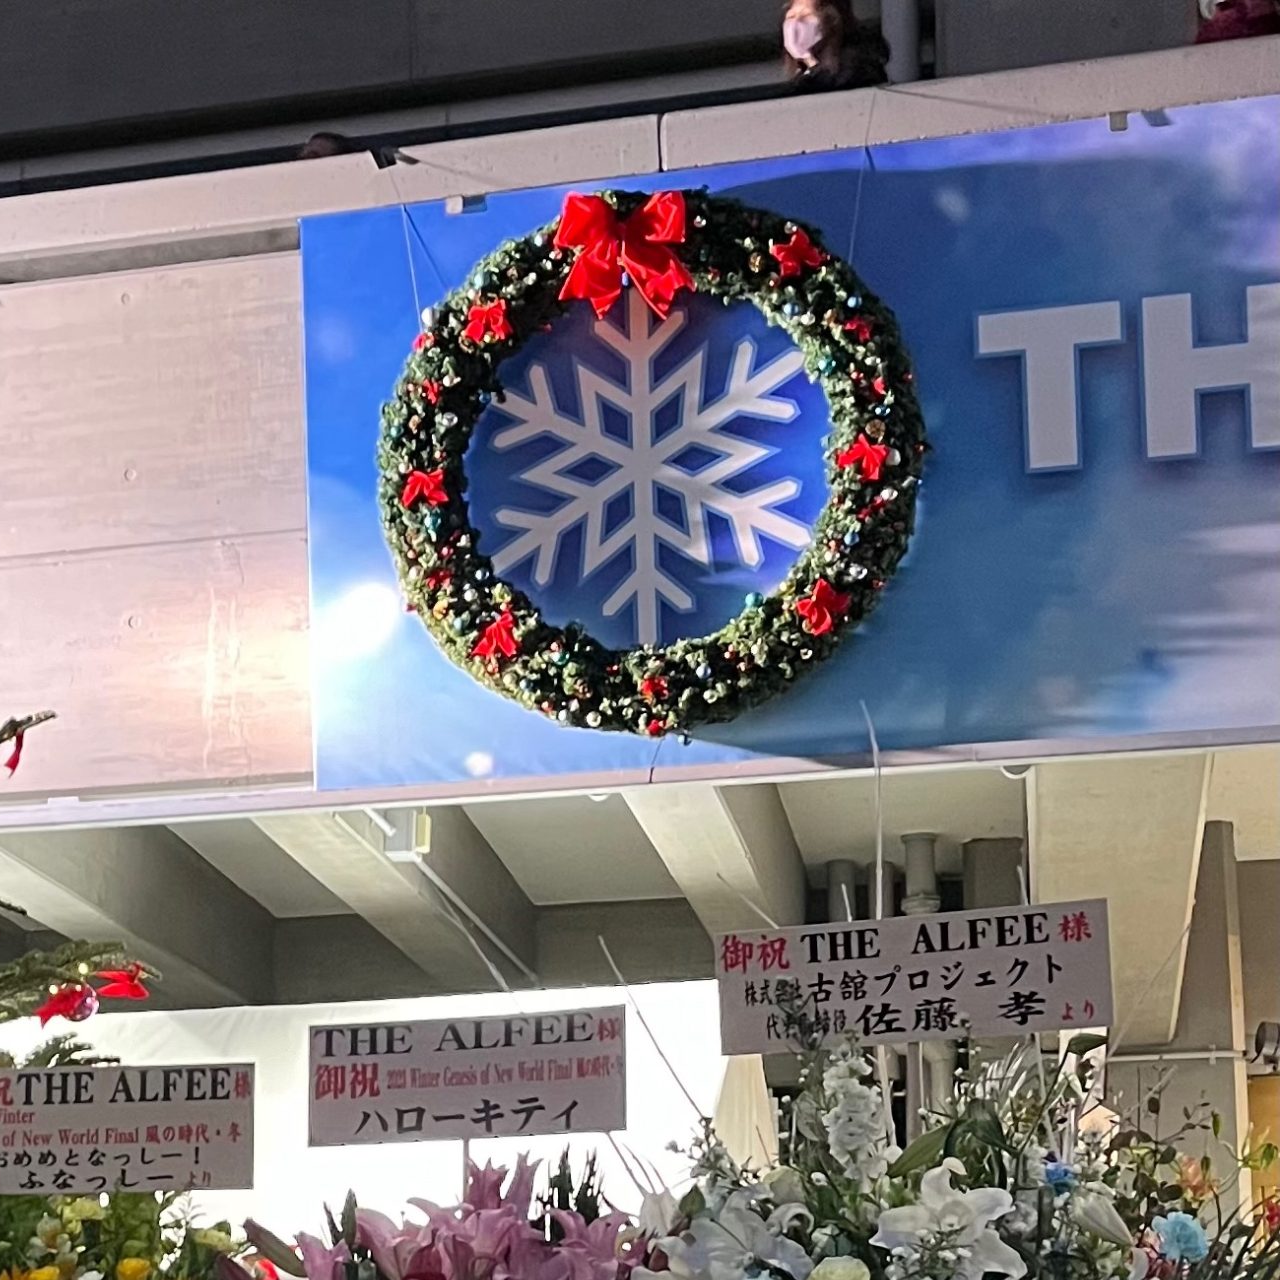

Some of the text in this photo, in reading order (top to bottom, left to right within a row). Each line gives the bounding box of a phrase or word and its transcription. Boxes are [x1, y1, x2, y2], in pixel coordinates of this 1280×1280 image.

[720, 911, 1092, 975] 御祝 THE ALFEE 様
[314, 1025, 413, 1057] THE
[433, 1012, 595, 1051] ALFEE
[855, 996, 959, 1037] 佐藤
[1060, 1000, 1095, 1022] より
[17, 1071, 95, 1105] THE
[108, 1067, 232, 1104] ALFEE
[233, 1070, 253, 1099] 様
[314, 1062, 380, 1100] 御祝
[353, 1096, 579, 1136] ハローキティ
[2, 1129, 16, 1147] of
[22, 1130, 52, 1147] New
[58, 1128, 99, 1145] World
[105, 1127, 139, 1144] Final
[19, 1168, 174, 1190] ふなっしー
